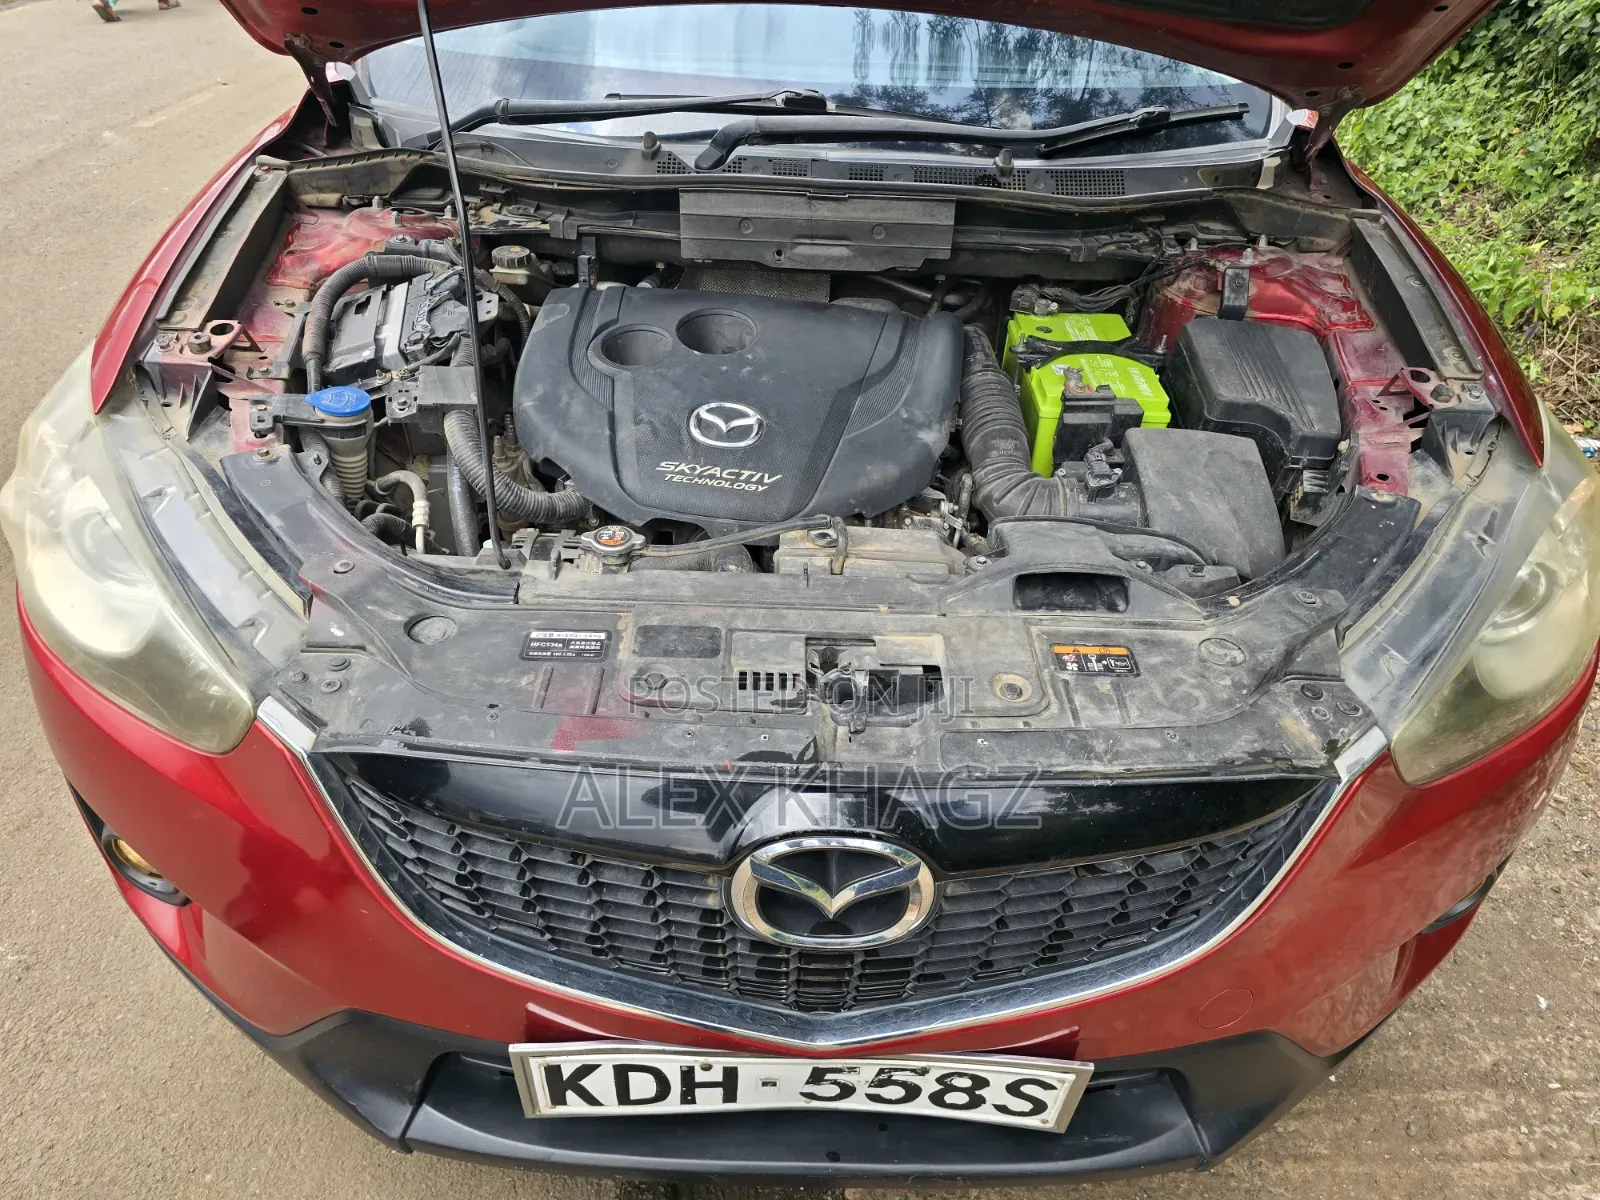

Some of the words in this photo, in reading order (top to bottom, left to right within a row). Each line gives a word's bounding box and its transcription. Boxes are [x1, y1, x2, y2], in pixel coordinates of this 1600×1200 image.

[655, 461, 782, 483] SKYACTIV
[664, 474, 769, 492] TECHNOLOGY
[543, 1063, 738, 1106] KDH
[799, 1066, 1059, 1117] 558S
